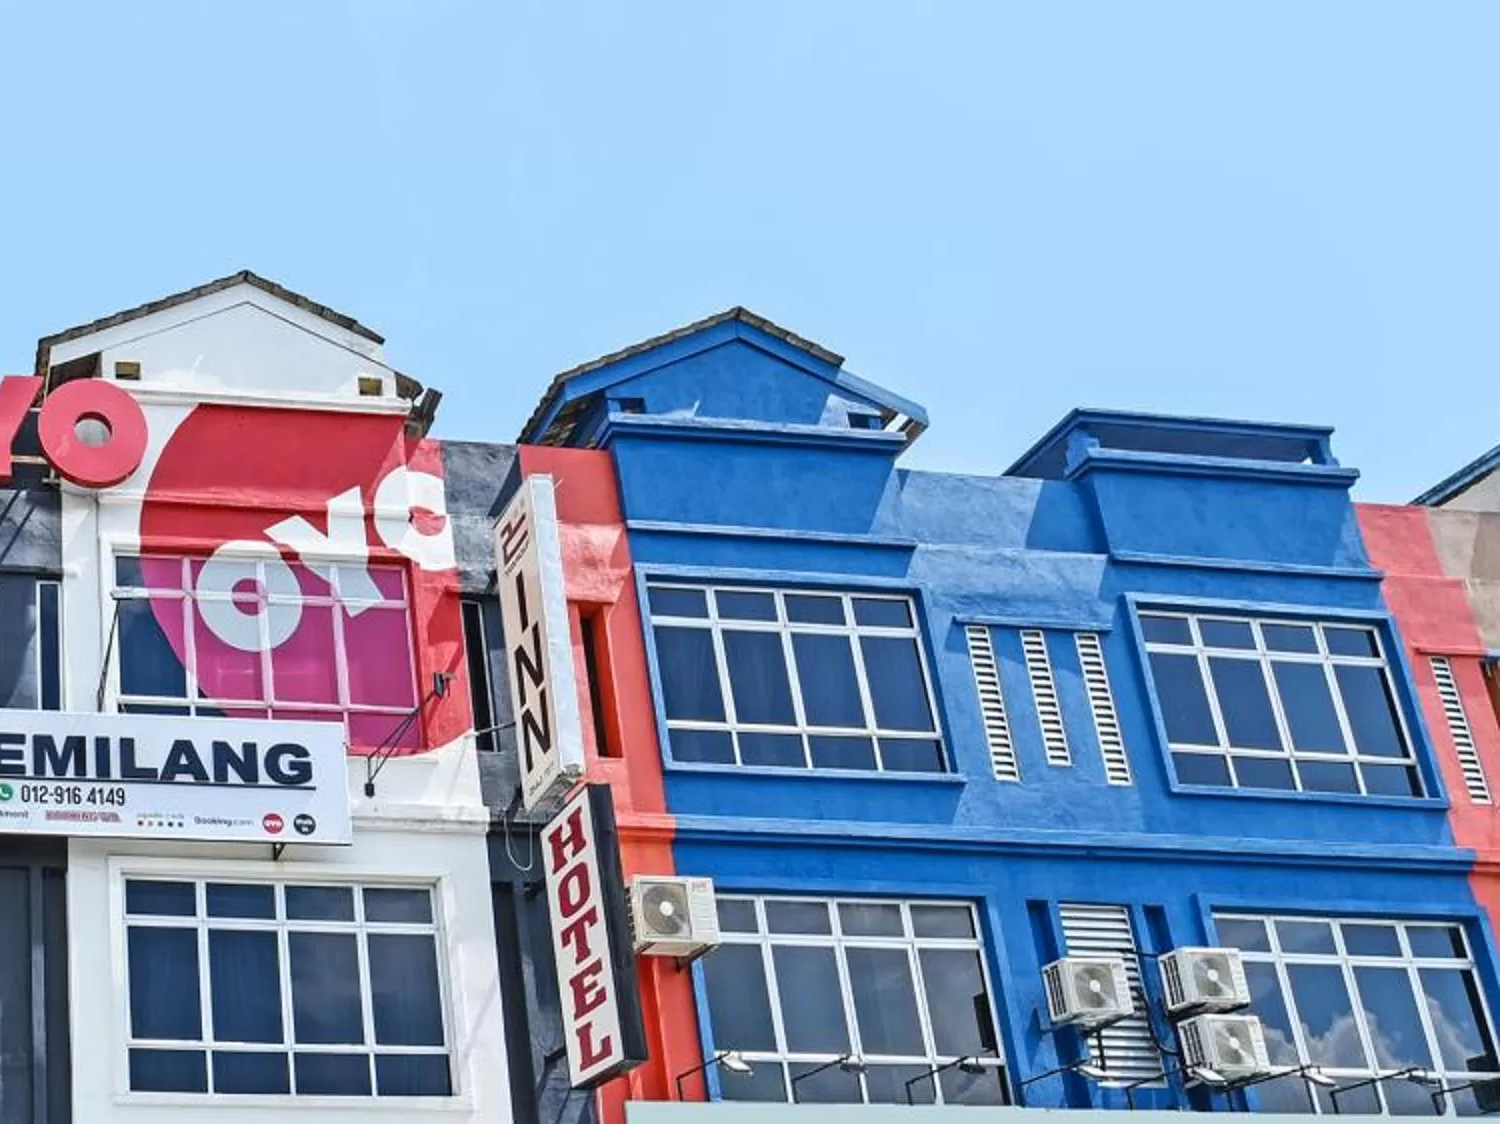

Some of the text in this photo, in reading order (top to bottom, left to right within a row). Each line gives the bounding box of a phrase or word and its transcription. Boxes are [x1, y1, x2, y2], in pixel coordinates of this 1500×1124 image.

[196, 464, 455, 651] OYO
[21, 784, 126, 807] 012-916 4149
[550, 805, 613, 1073] HOTEL
